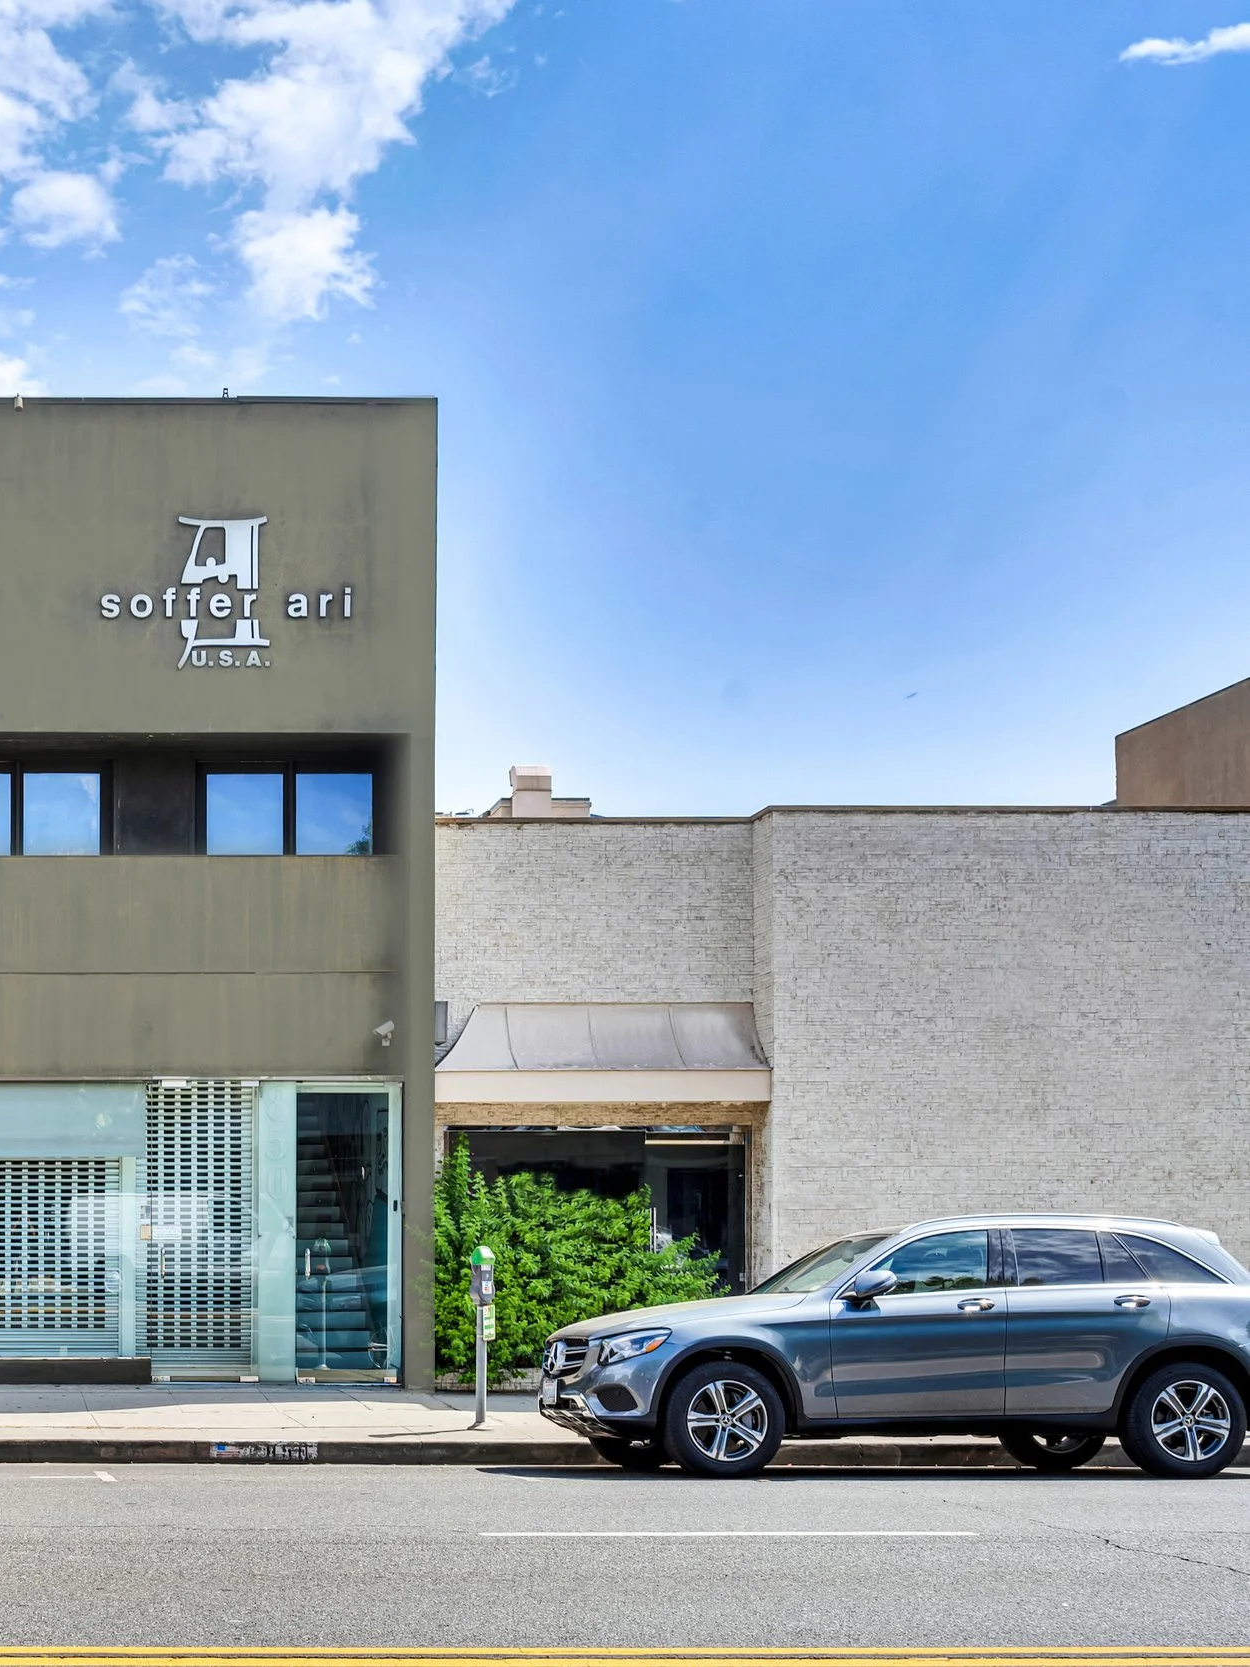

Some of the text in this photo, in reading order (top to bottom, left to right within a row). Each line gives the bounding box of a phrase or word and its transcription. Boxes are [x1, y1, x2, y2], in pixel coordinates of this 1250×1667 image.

[100, 587, 353, 619] soffer ari
[191, 650, 271, 668] U.S.A.
